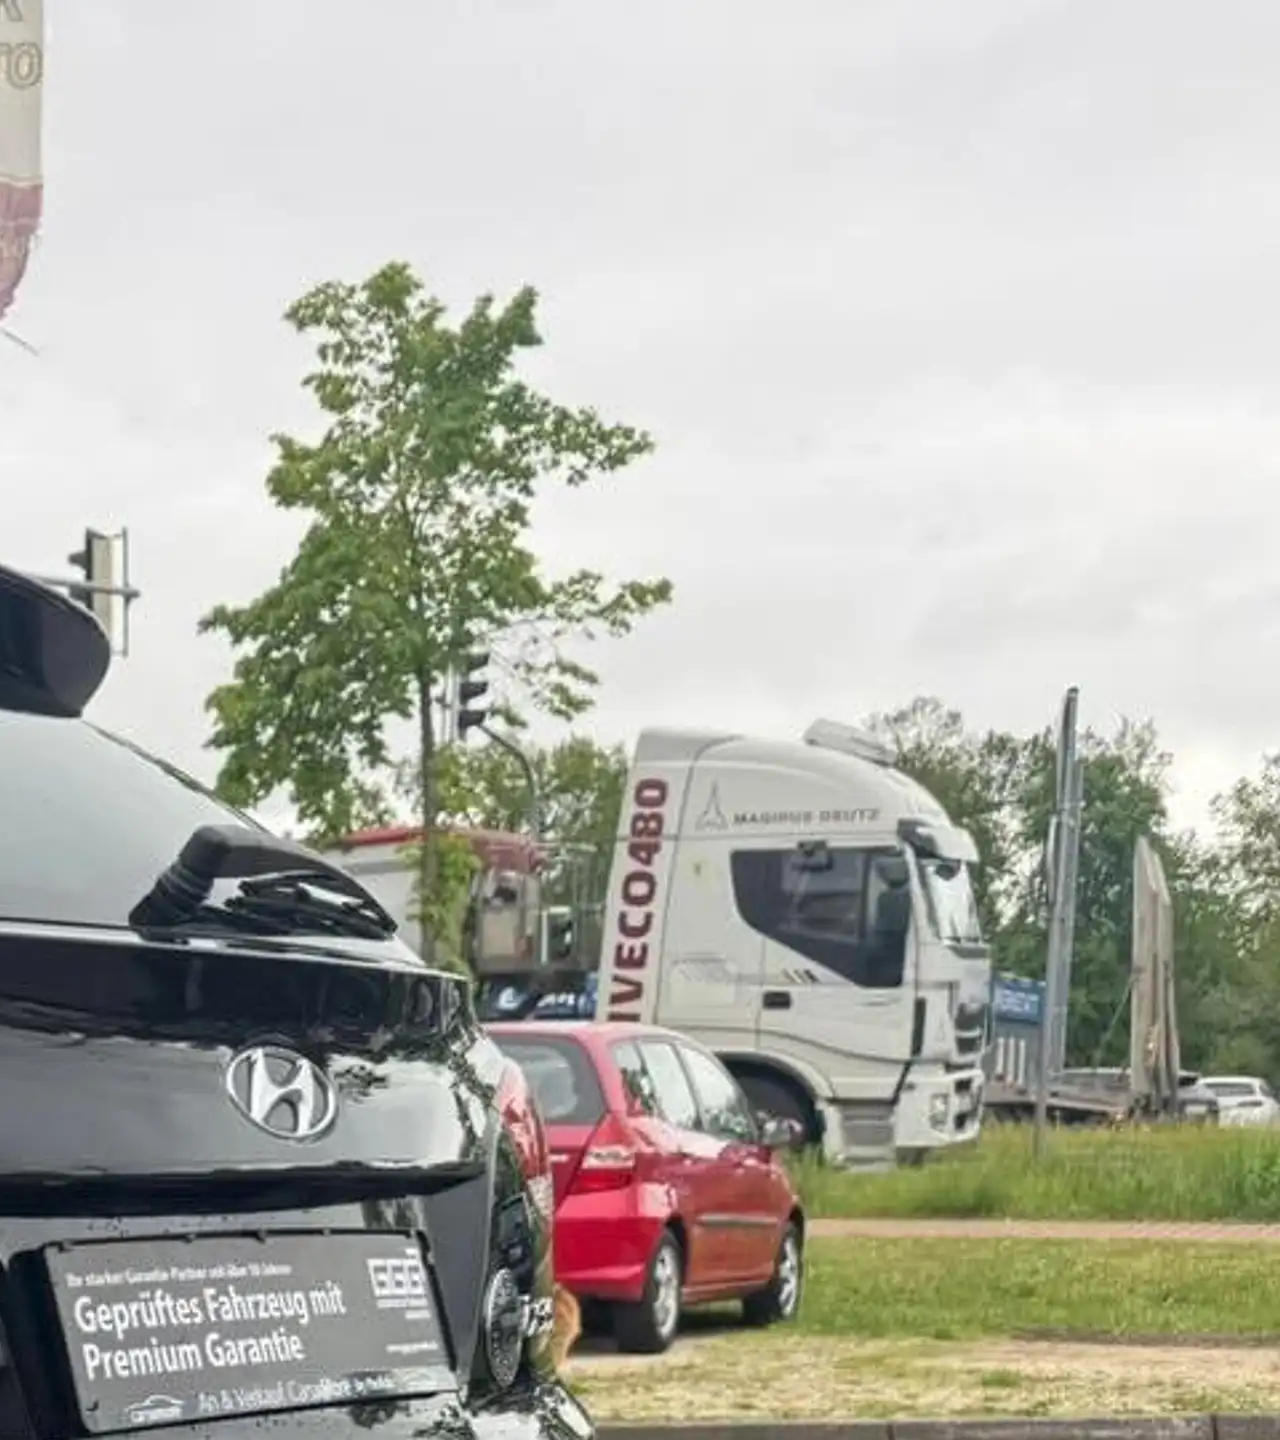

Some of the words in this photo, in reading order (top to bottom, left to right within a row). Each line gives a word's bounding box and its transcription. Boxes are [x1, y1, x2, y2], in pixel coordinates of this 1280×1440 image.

[74, 1288, 203, 1340] Geprüftes
[202, 1284, 309, 1325] Fahrzeug
[308, 1280, 347, 1315] mit
[82, 1337, 204, 1381] Premium
[205, 1326, 306, 1368] Garantie
